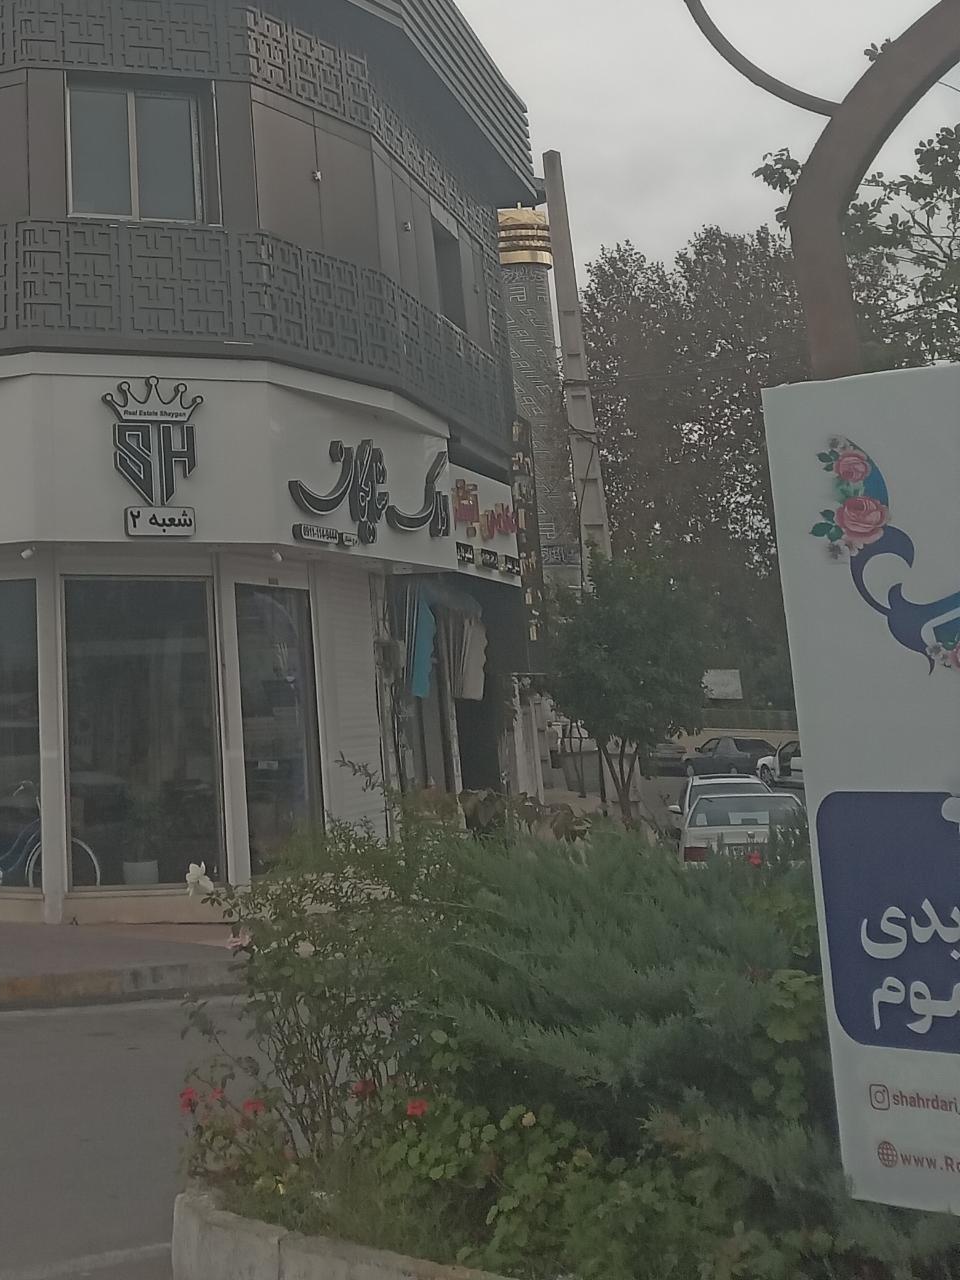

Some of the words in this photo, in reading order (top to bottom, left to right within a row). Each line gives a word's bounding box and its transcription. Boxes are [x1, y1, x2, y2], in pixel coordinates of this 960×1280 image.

[129, 509, 141, 529] ۲
[148, 509, 193, 533] شعبه
[893, 1091, 960, 1115] shahrdari
